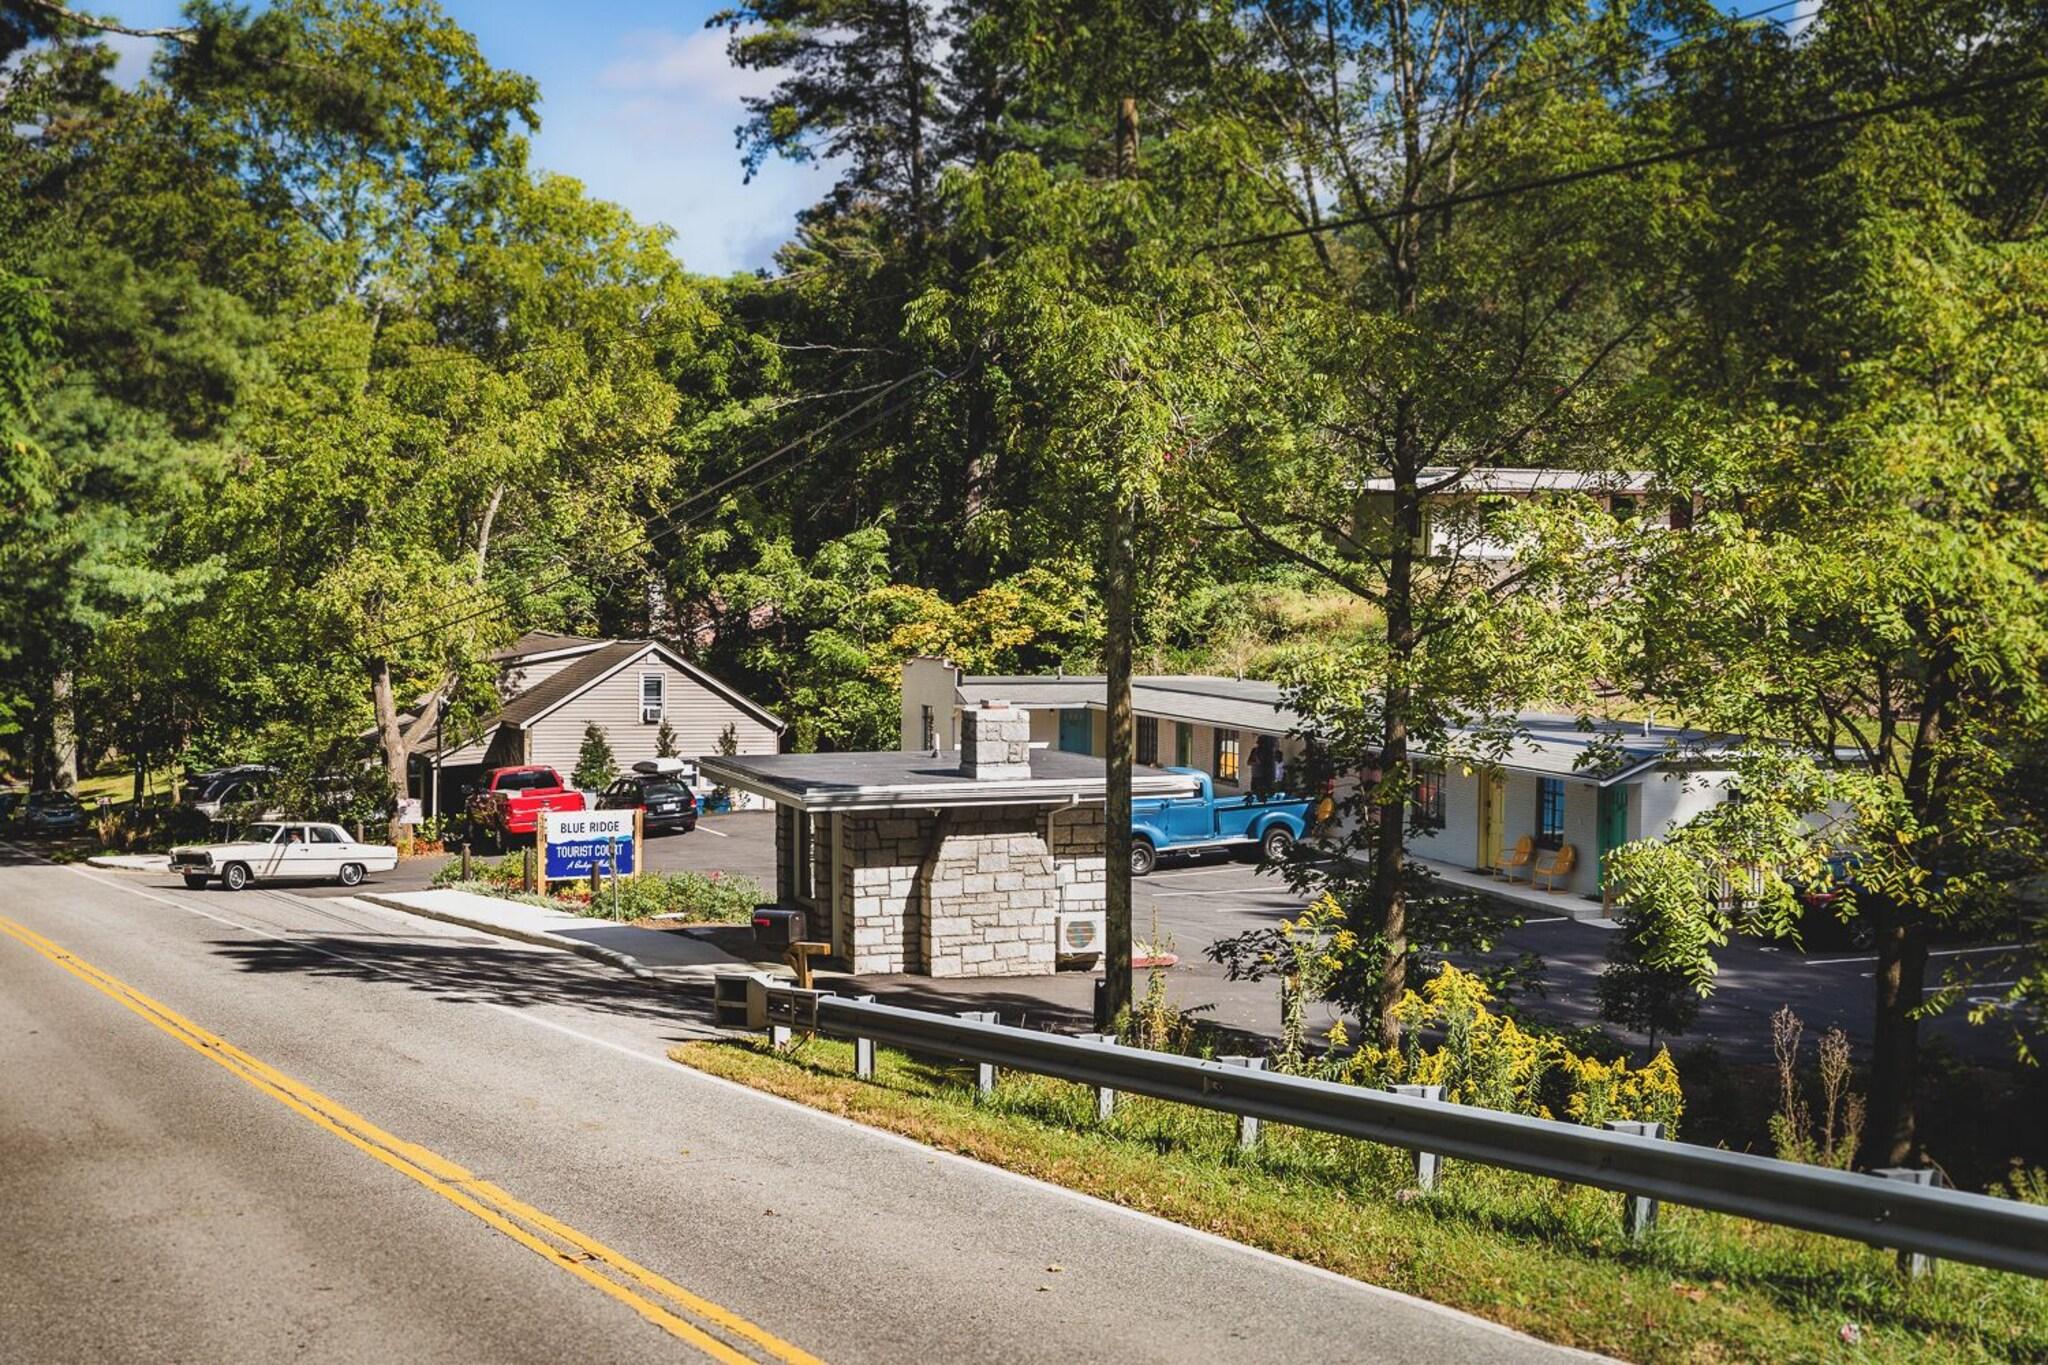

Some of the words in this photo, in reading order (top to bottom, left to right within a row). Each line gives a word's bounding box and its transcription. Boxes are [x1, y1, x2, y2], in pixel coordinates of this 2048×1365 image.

[561, 822, 585, 833] BLUE
[590, 821, 619, 832] RIDGE
[556, 845, 593, 858] TOURIST
